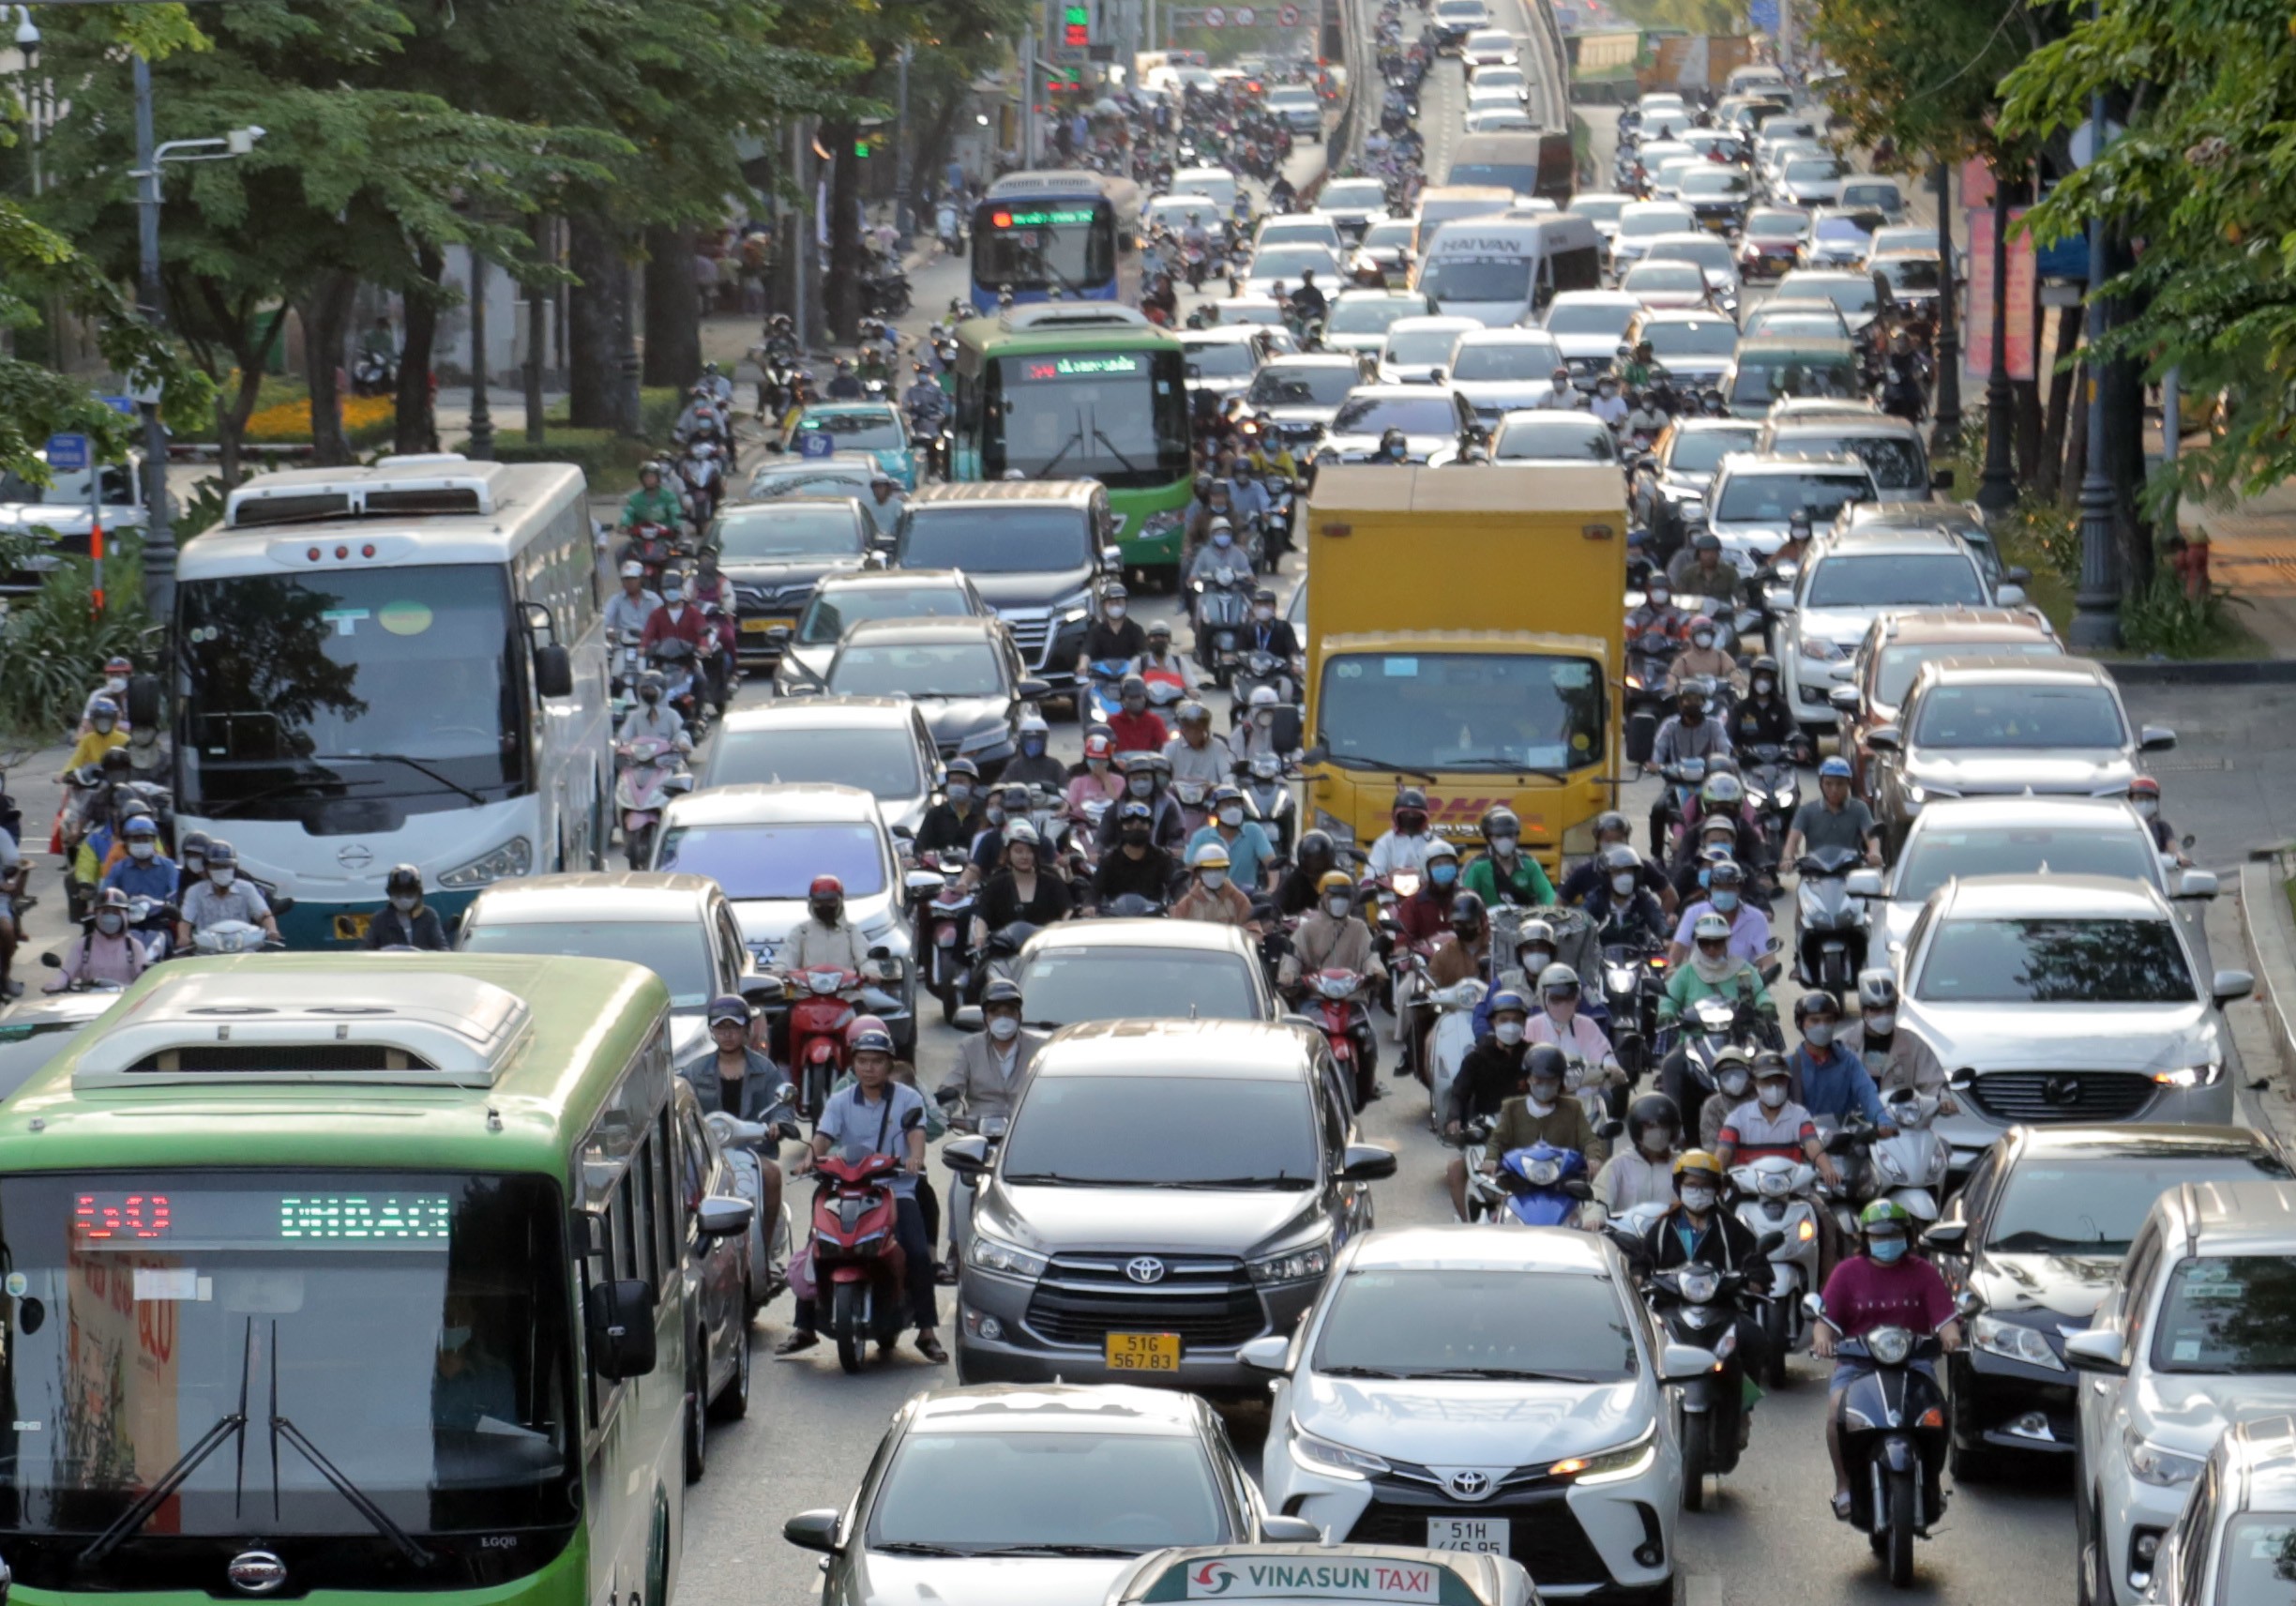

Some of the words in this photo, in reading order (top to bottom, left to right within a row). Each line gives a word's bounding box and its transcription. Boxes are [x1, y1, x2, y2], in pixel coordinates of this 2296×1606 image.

[1127, 1336, 1158, 1352] 51G
[1114, 1354, 1171, 1370] 567.83
[1451, 1522, 1487, 1539] 51H
[1247, 1565, 1369, 1589] VINASUN
[1374, 1568, 1430, 1593] TAXI
